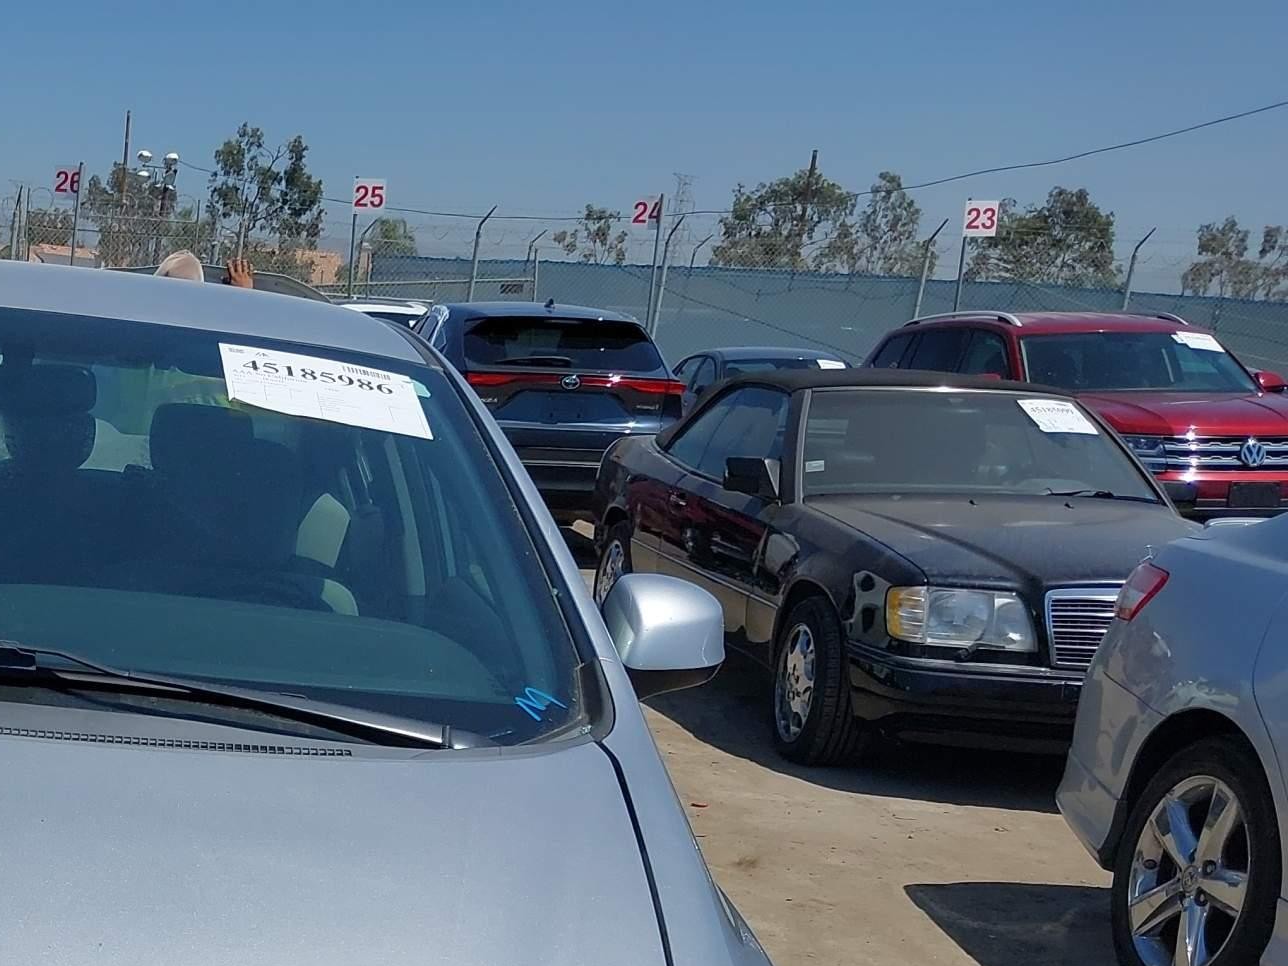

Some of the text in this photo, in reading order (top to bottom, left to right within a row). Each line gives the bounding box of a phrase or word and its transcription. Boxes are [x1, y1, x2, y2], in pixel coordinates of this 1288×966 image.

[54, 170, 81, 193] 26
[353, 185, 384, 208] 25
[632, 201, 661, 224] 24
[965, 207, 996, 230] 23
[242, 360, 394, 395] 45185986
